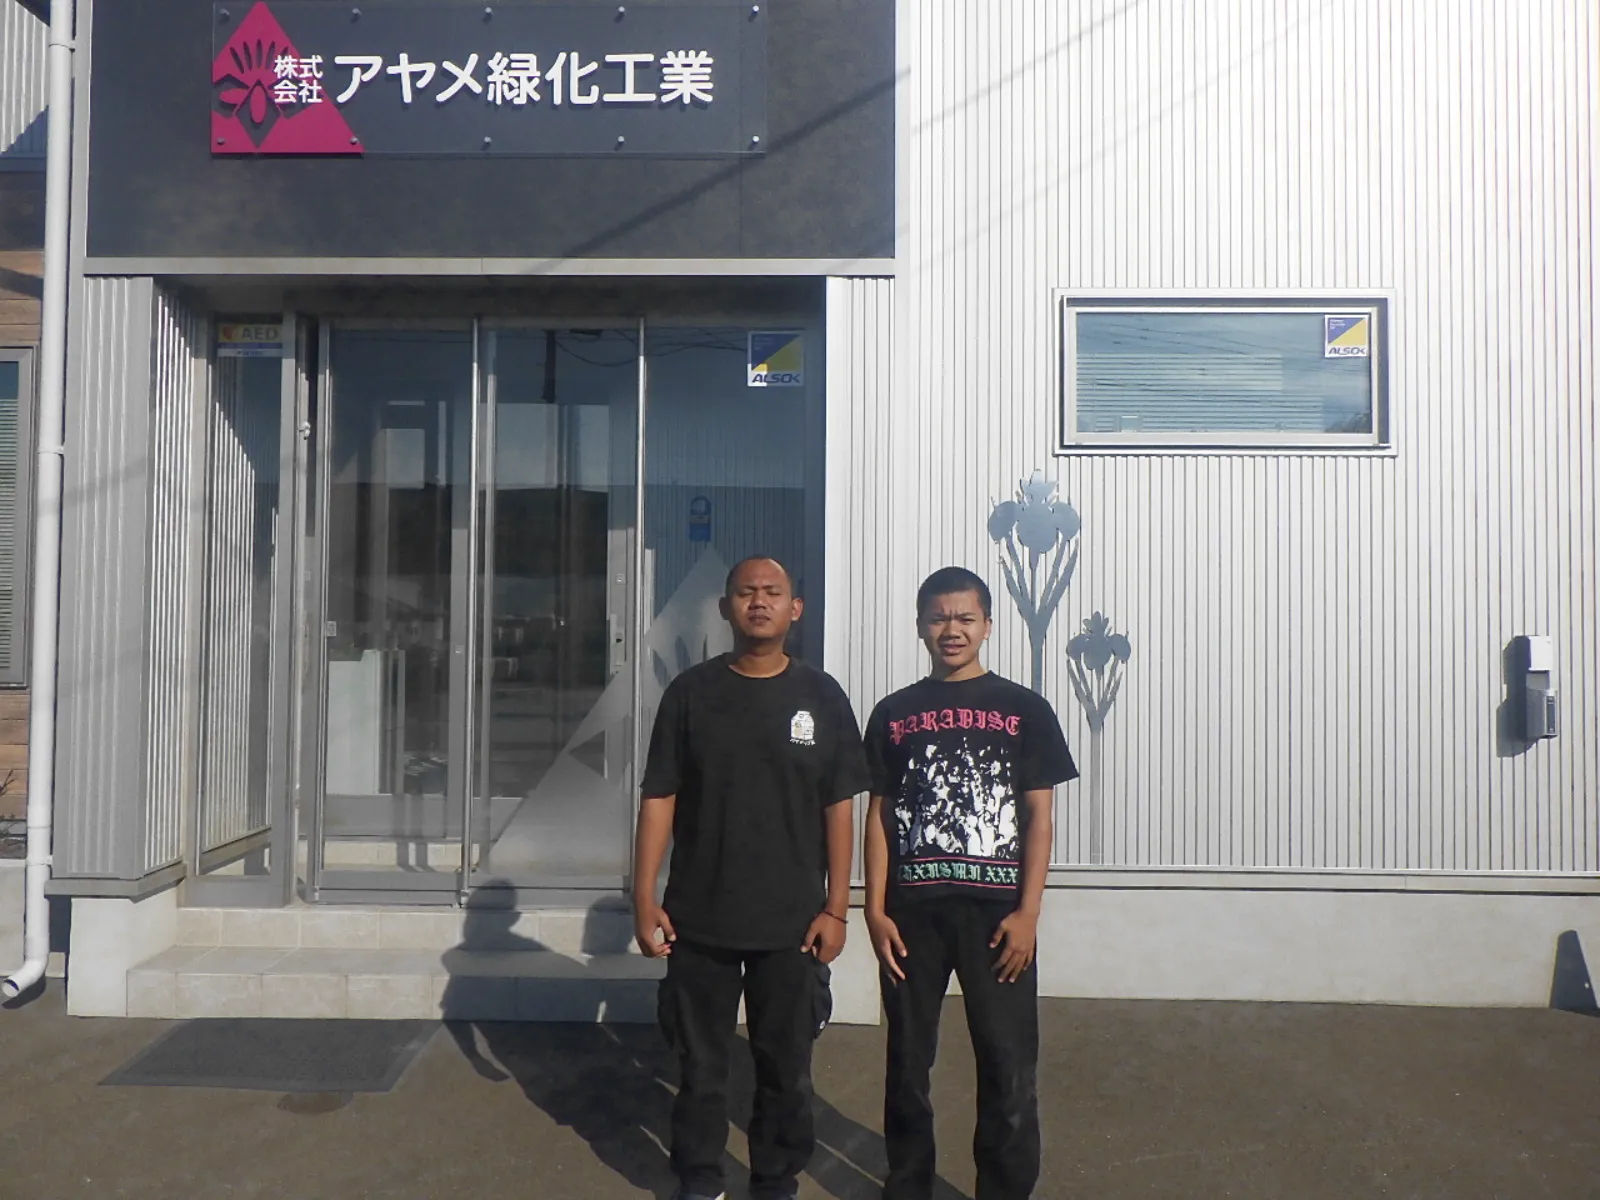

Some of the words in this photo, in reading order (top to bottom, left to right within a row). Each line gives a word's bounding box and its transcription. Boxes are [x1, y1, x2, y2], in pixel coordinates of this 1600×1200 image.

[273, 55, 323, 79] 株式
[334, 50, 713, 105] アヤメ緑化工業
[273, 80, 322, 103] 会社
[241, 327, 279, 340] AED
[1328, 346, 1366, 355] ALSOK
[752, 373, 801, 384] ALSOK
[889, 707, 1021, 745] PARADISE
